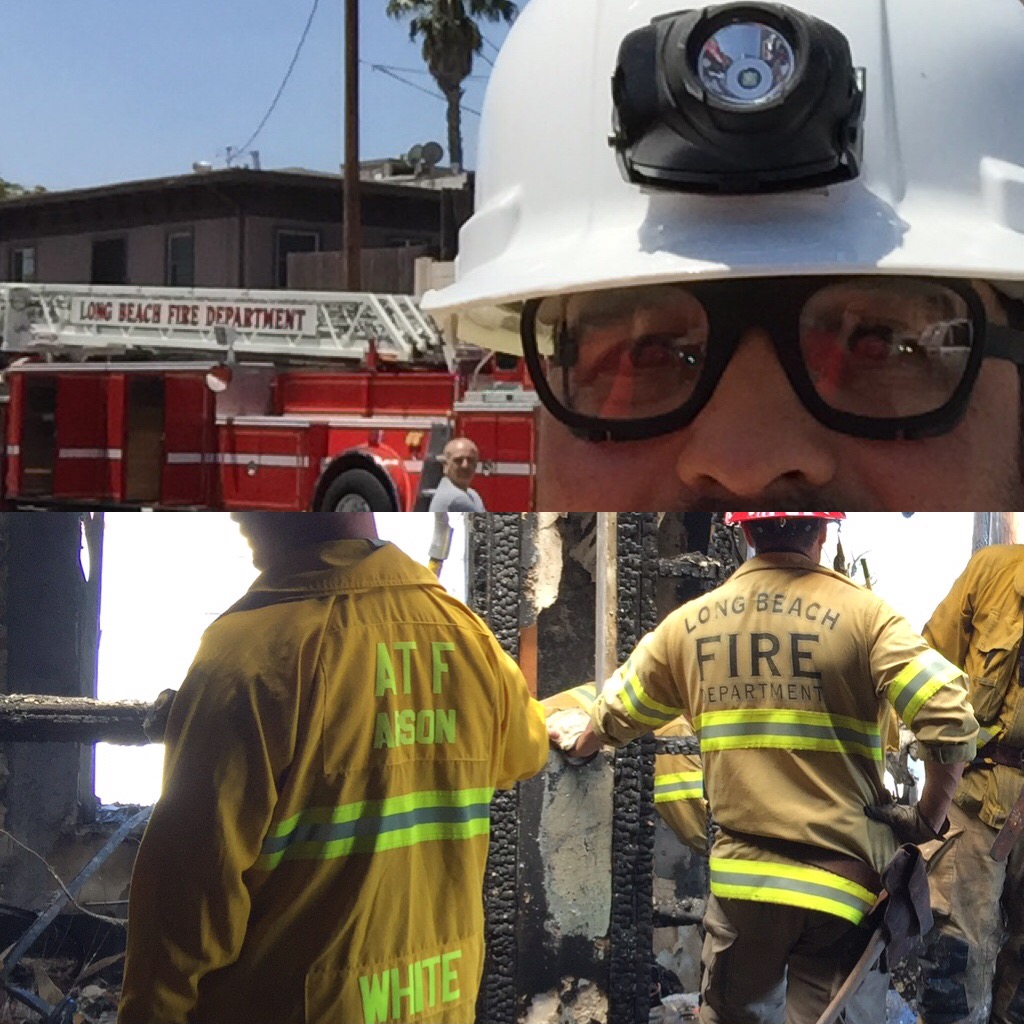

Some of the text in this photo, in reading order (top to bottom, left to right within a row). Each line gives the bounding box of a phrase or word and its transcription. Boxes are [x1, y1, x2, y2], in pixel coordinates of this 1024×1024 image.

[80, 301, 305, 331] LONG BEACH FIRE DEPARTMENT
[684, 592, 840, 634] LONG BEACH
[696, 632, 821, 681] FIRE
[359, 949, 462, 1024] WHITE
